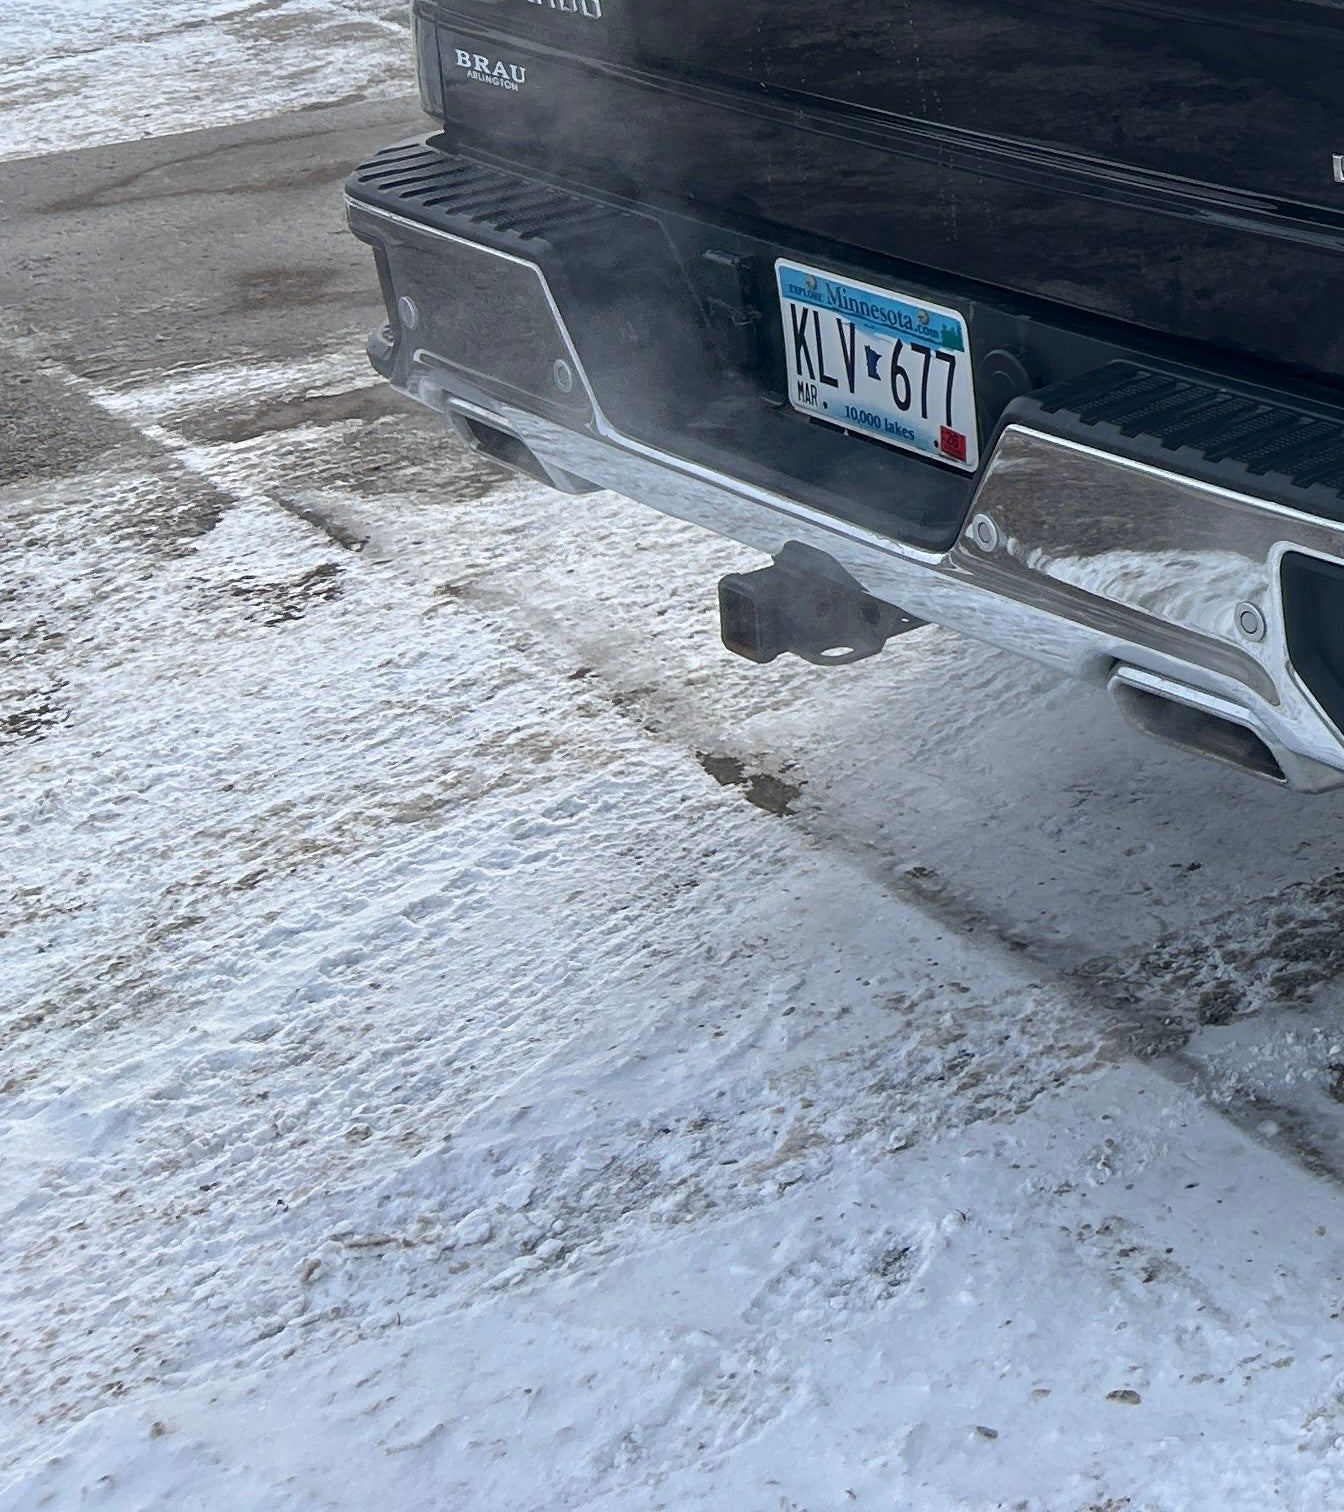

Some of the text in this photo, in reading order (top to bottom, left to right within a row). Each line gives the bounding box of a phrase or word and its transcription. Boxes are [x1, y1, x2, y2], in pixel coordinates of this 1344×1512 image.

[455, 48, 526, 84] BRAU
[467, 68, 519, 91] ARLINGTON
[790, 303, 956, 428] KLV 677
[845, 405, 915, 441] 10,000 lakes
